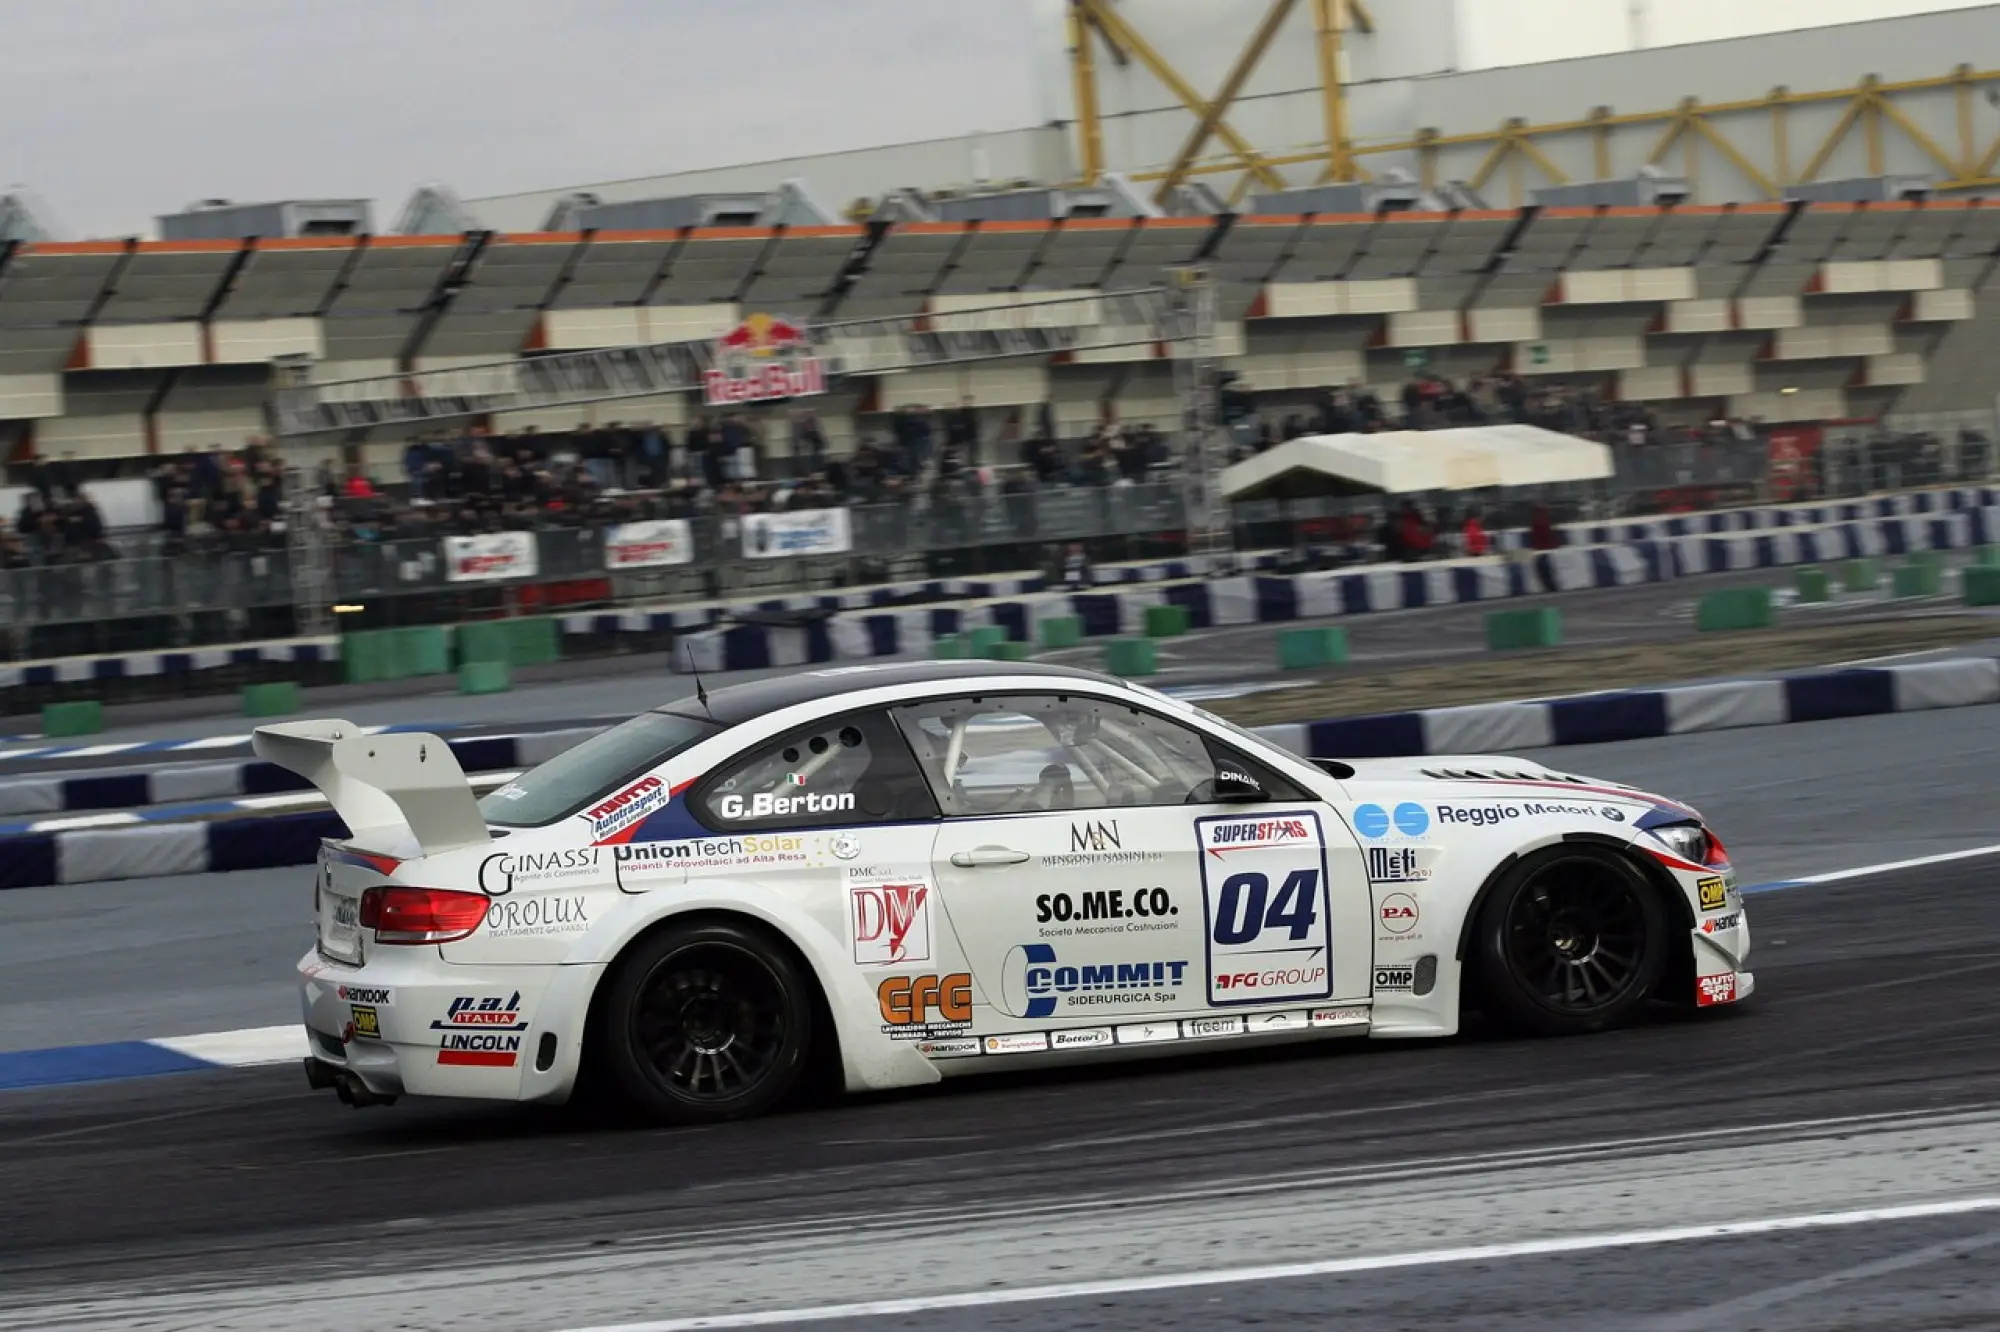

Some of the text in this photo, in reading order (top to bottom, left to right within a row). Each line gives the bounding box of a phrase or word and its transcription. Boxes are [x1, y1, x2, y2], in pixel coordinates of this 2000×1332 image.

[721, 792, 856, 819] G.Berton
[1437, 803, 1596, 826] Reggio Motori
[1213, 820, 1309, 843] SUPERSTARS
[735, 856, 749, 864] ad
[752, 854, 775, 862] Alta
[777, 853, 807, 861] Resa
[487, 896, 588, 929] OROLUX
[1036, 886, 1179, 924] SO.ME.CO.
[1213, 869, 1320, 945] 04
[1382, 907, 1416, 919] PA
[1027, 960, 1189, 993] COMMIT
[1376, 971, 1413, 985] OMP
[1068, 993, 1176, 1006] SIDERURGICA Spa
[457, 1014, 511, 1023] ITALIA
[440, 1034, 520, 1051] LINCOLN
